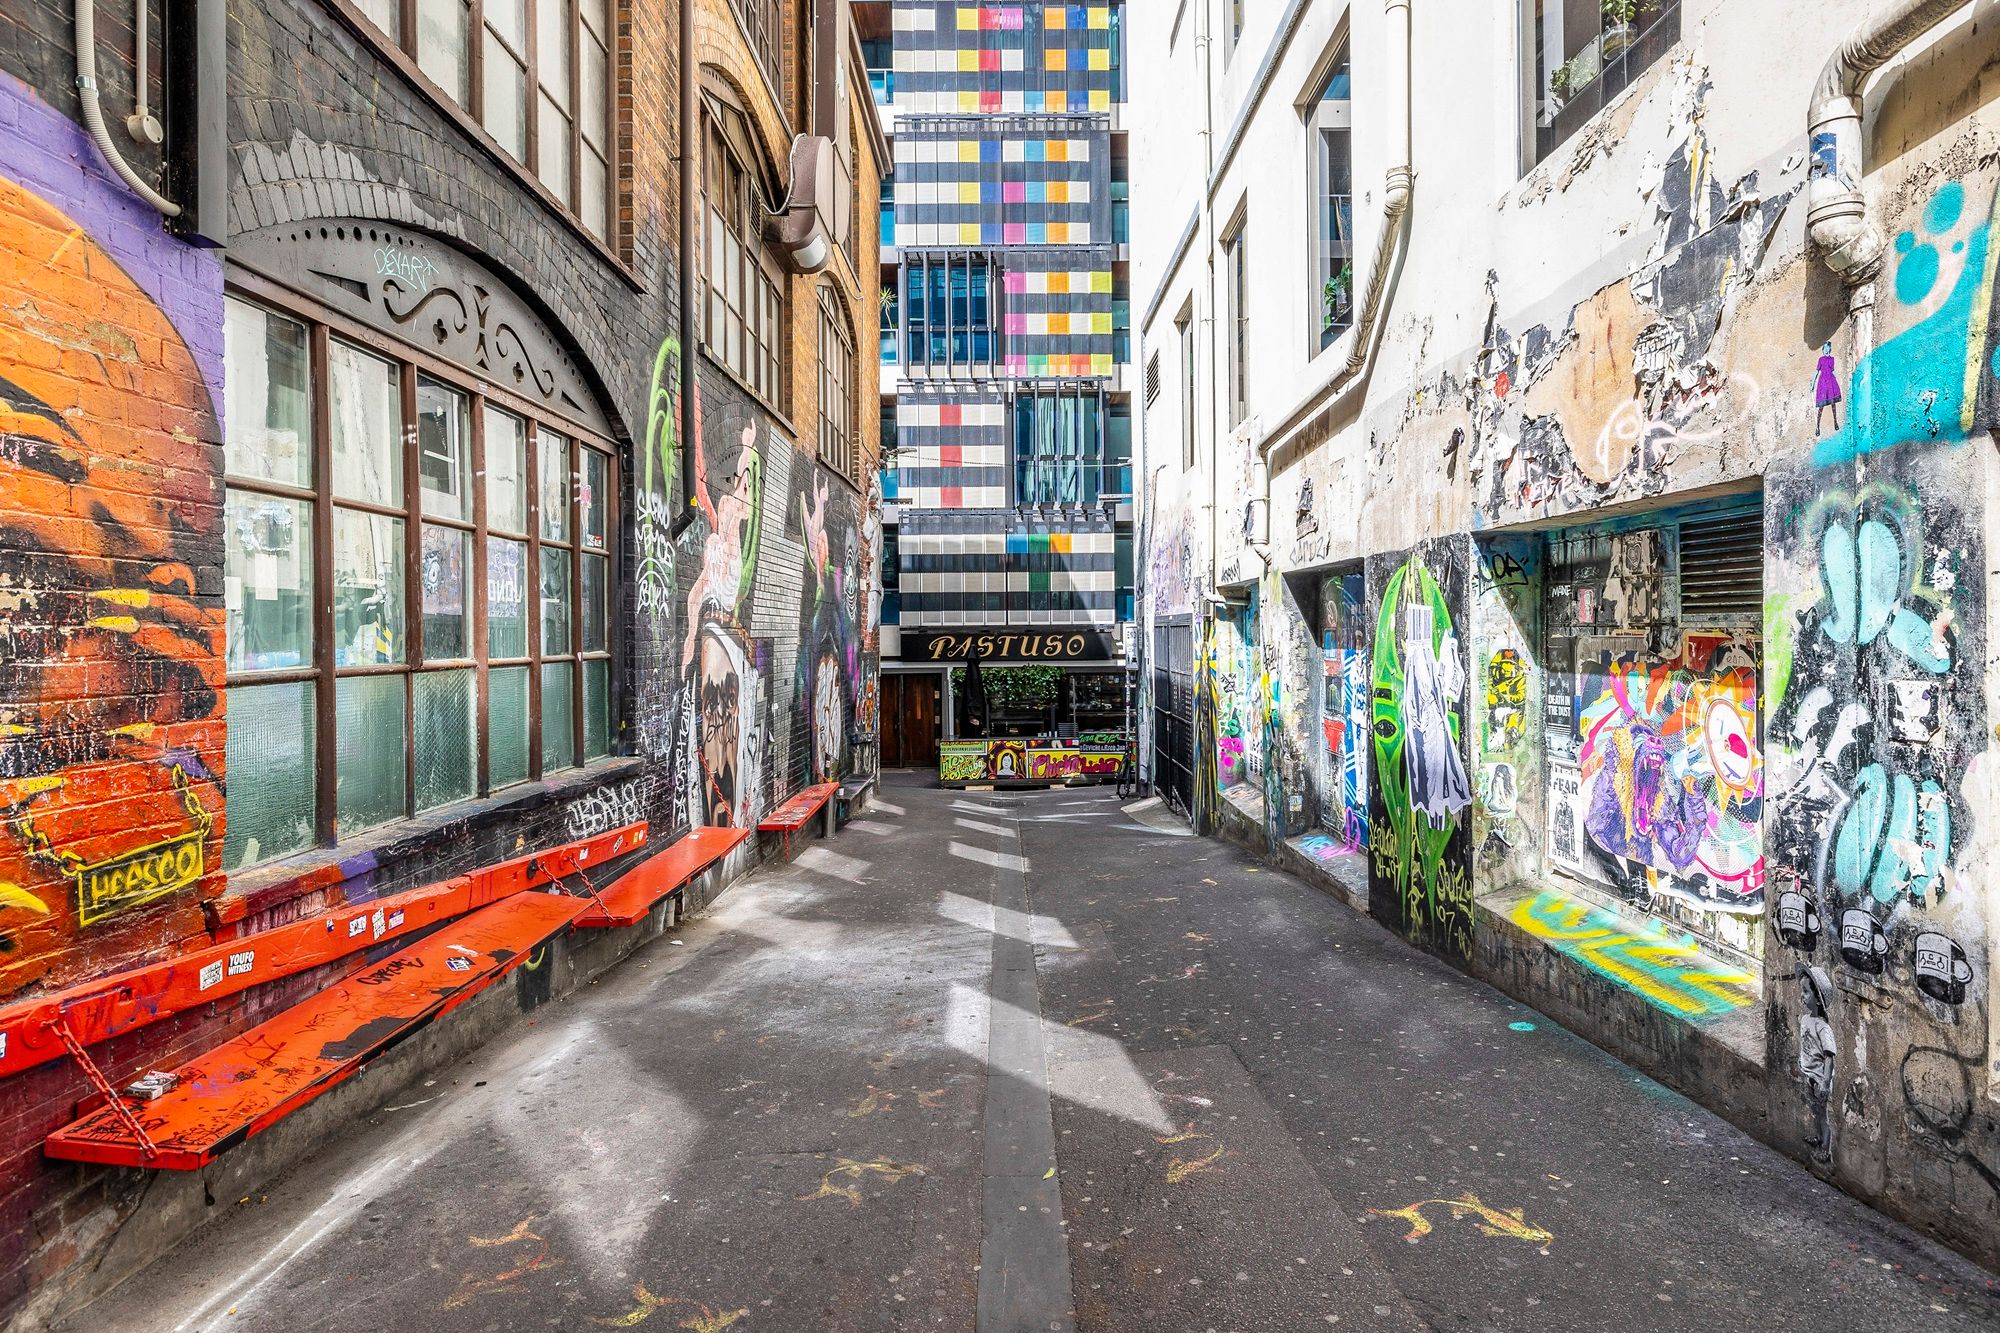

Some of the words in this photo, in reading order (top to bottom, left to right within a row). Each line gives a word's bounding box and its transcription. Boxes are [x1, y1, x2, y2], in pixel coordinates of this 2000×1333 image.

[928, 634, 1085, 659] PASTUSO
[1548, 694, 1564, 705] DEATH
[1565, 695, 1571, 706] IN
[1548, 704, 1558, 716] THE
[1558, 706, 1571, 717] DUST
[1553, 777, 1578, 796] FEAR
[1561, 850, 1580, 864] FETISH
[229, 950, 255, 967] YOUFO
[227, 962, 253, 976] WITNESS
